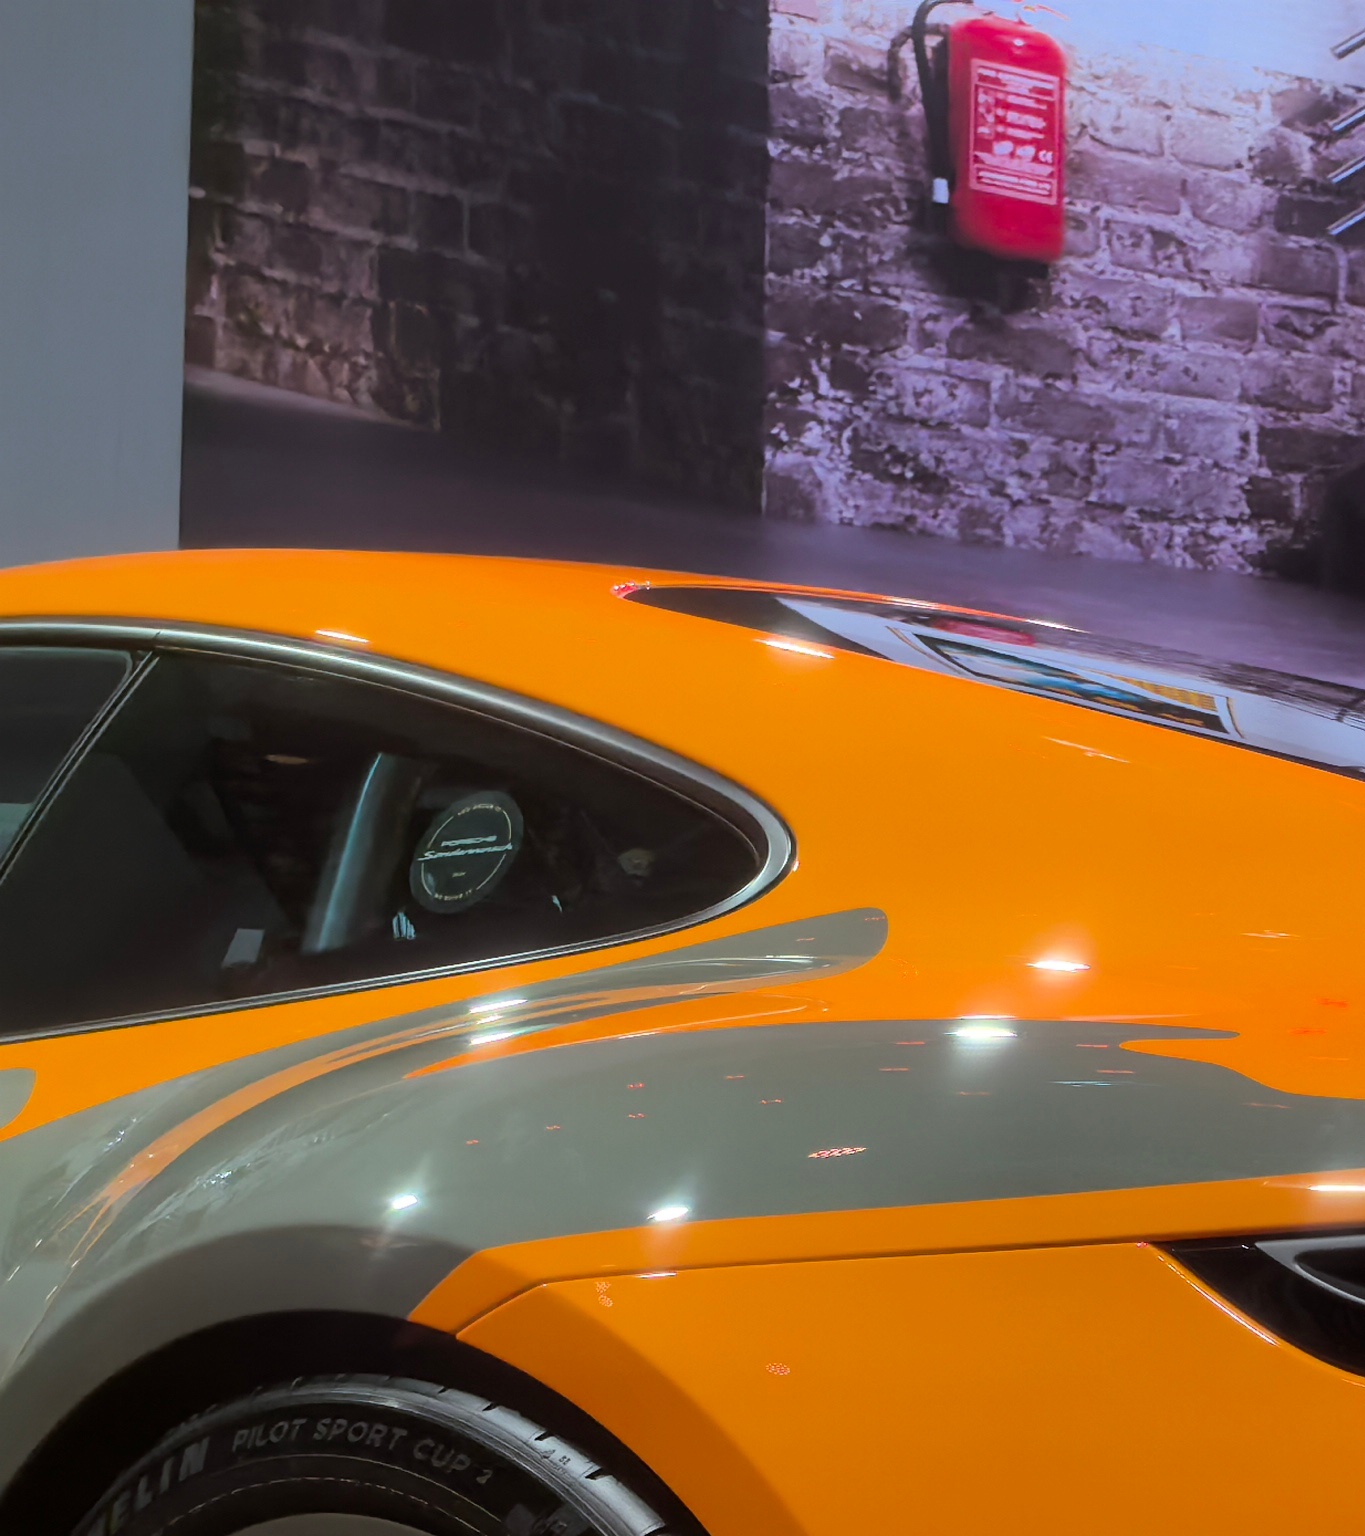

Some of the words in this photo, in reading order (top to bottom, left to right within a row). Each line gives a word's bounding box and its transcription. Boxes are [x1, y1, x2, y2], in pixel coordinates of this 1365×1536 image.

[230, 1417, 306, 1454] PILOT
[312, 1416, 407, 1451] SPORT
[413, 1438, 472, 1473] CUP
